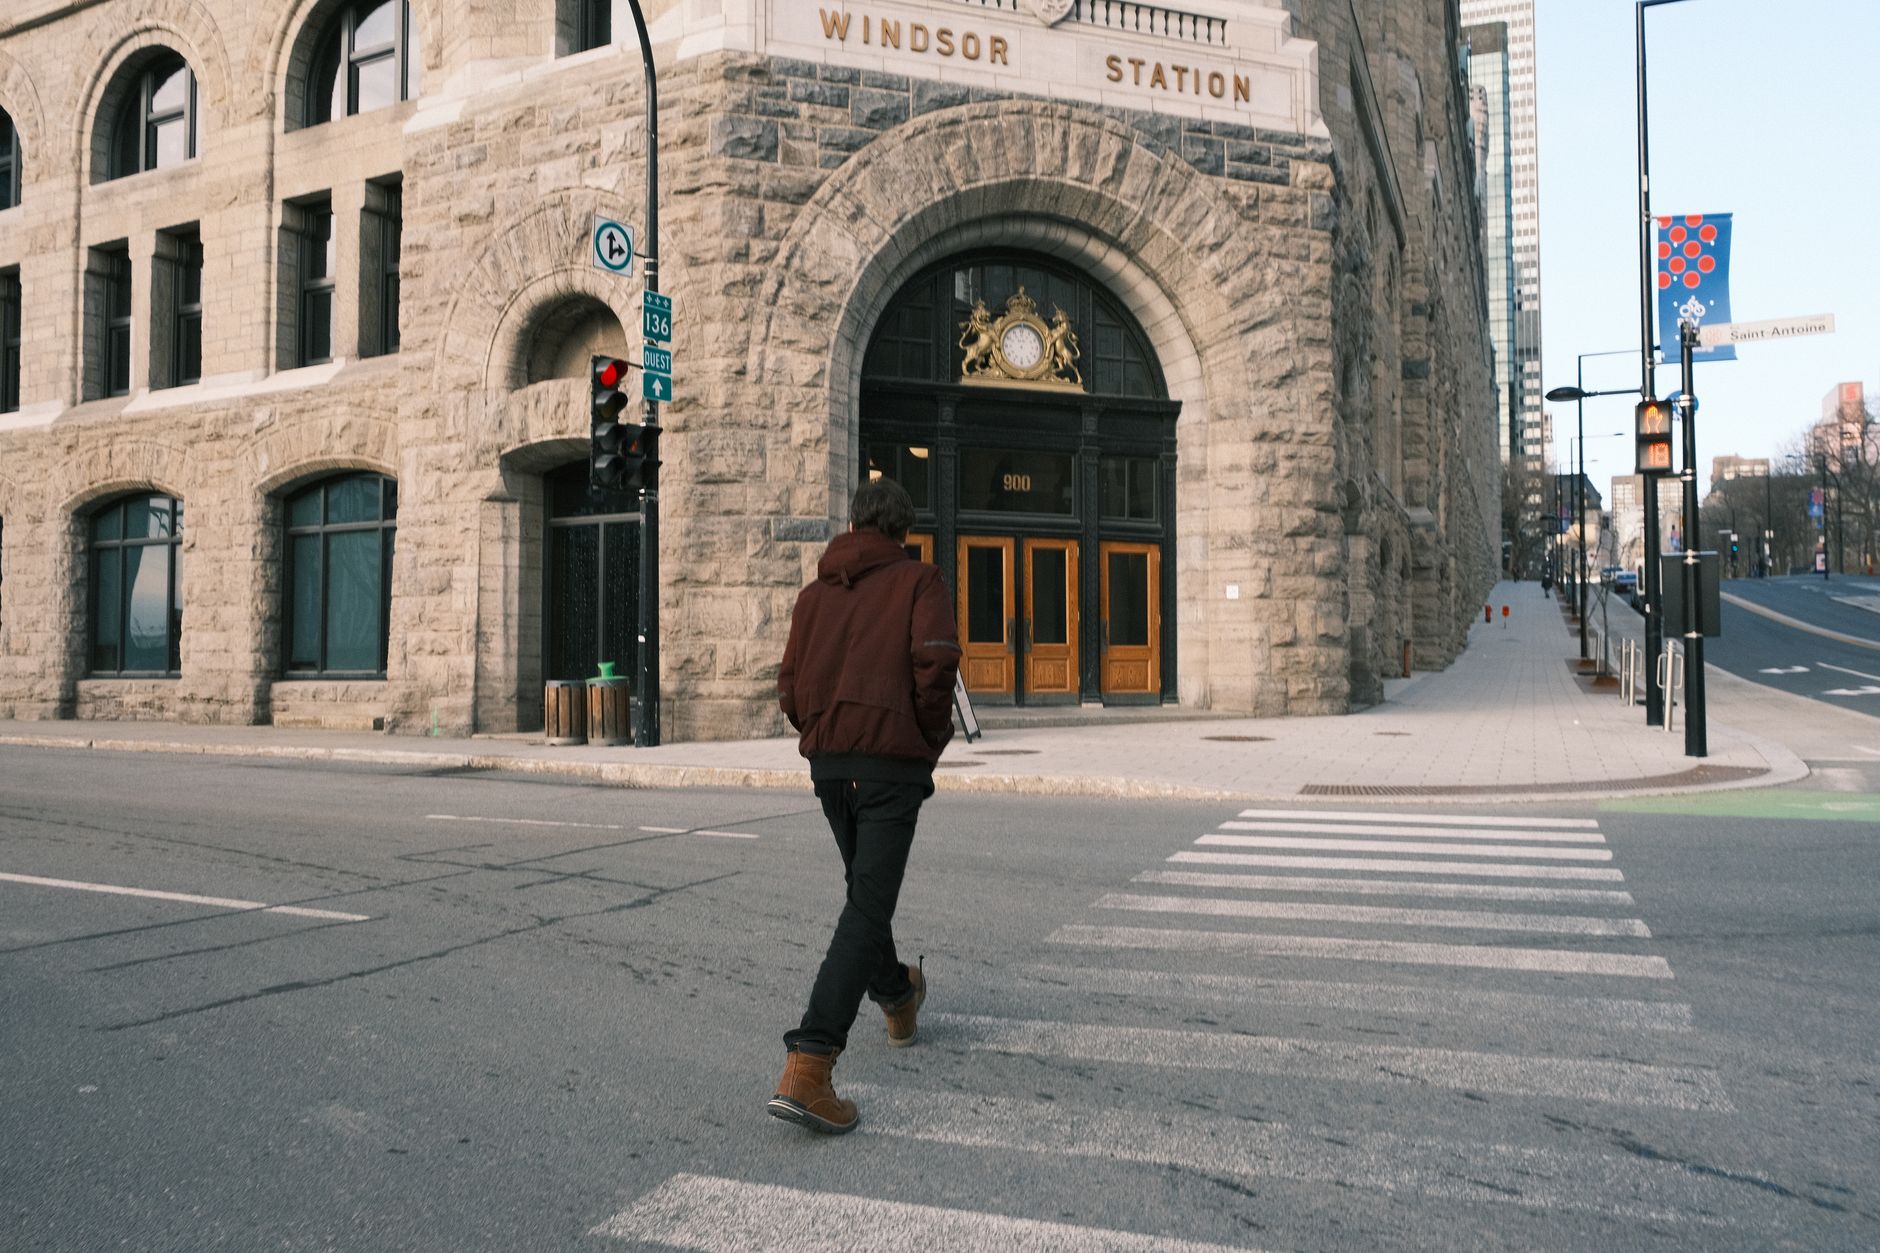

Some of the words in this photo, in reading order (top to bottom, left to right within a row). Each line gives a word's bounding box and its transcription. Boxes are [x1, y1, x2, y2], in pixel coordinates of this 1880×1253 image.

[819, 8, 1009, 65] WINDSOR
[1106, 55, 1250, 103] STATION
[646, 312, 669, 336] 136
[644, 351, 670, 371] OUEST
[1003, 474, 1031, 491] 900
